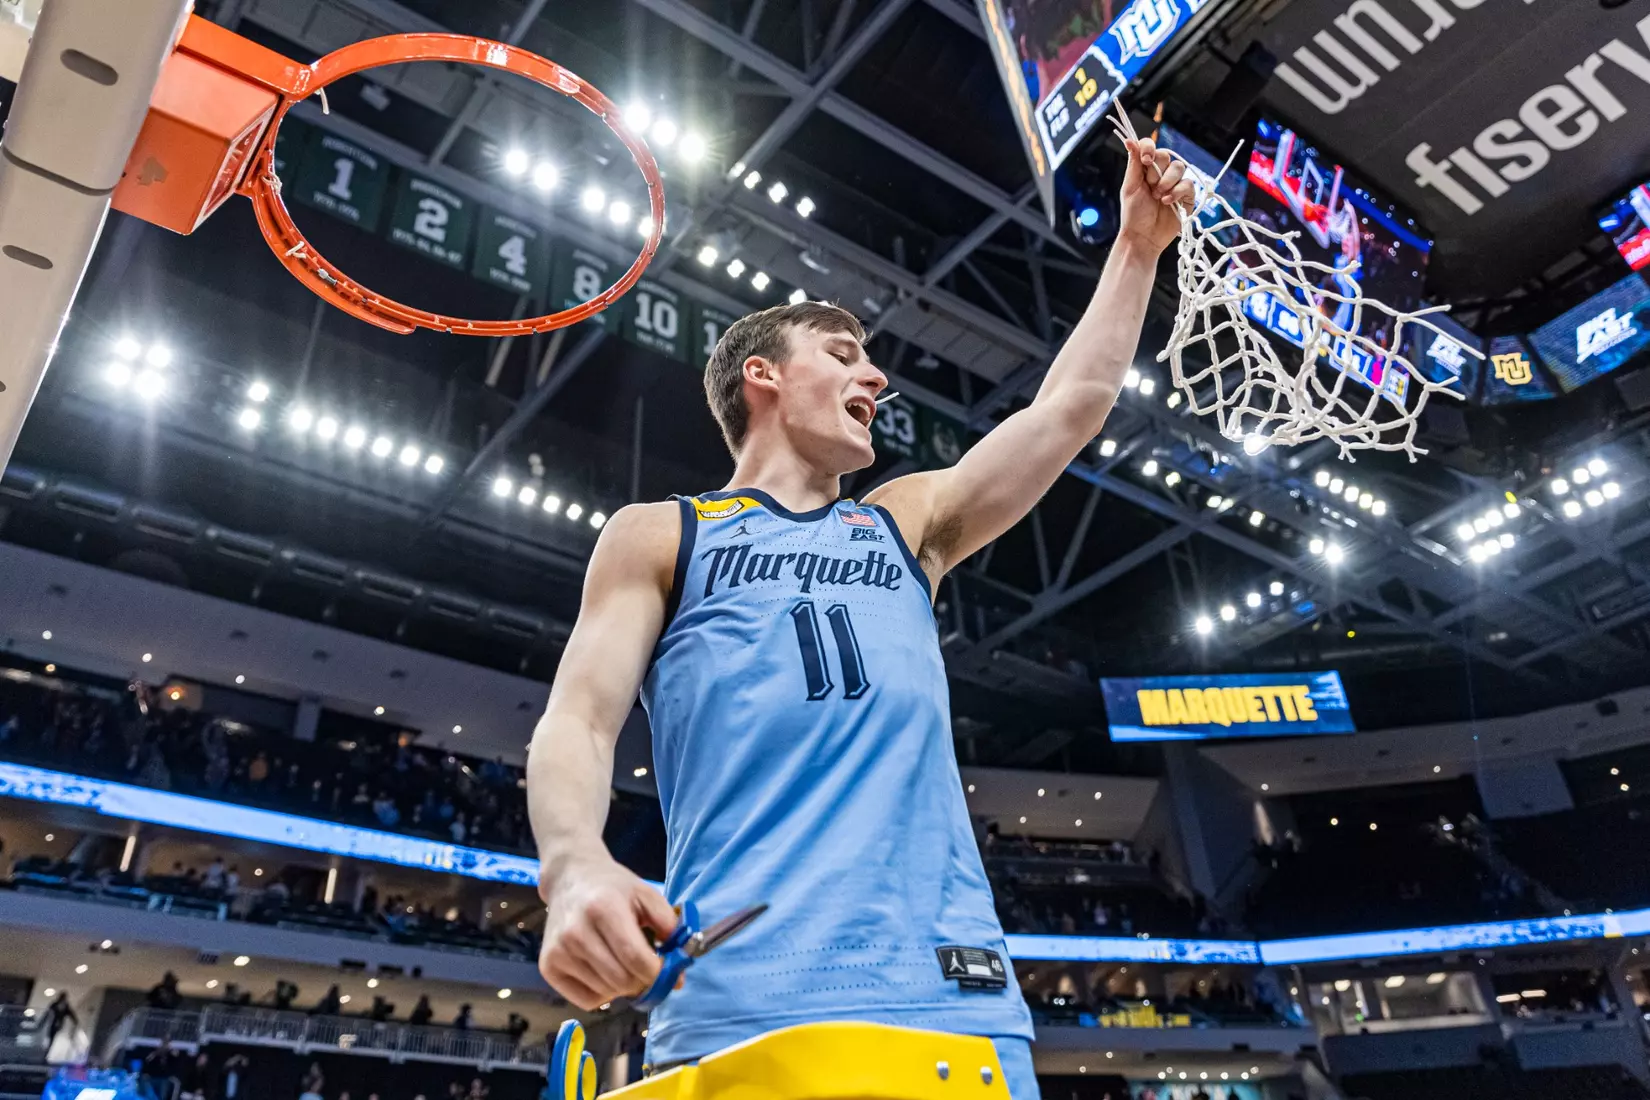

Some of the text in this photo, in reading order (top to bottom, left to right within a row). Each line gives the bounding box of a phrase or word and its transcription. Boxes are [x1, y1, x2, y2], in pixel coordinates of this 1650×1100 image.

[1074, 78, 1097, 107] 10
[328, 157, 353, 200] 1
[413, 197, 449, 243] 2
[498, 235, 527, 277] 4
[573, 263, 601, 304] 8
[634, 294, 679, 341] 10
[1491, 352, 1533, 386] MU
[876, 402, 916, 445] 33
[850, 534, 885, 542] EAST
[851, 527, 876, 535] BIG
[702, 544, 903, 599] Marquette
[790, 600, 871, 701] 11
[1137, 685, 1318, 727] MARQUETTE
